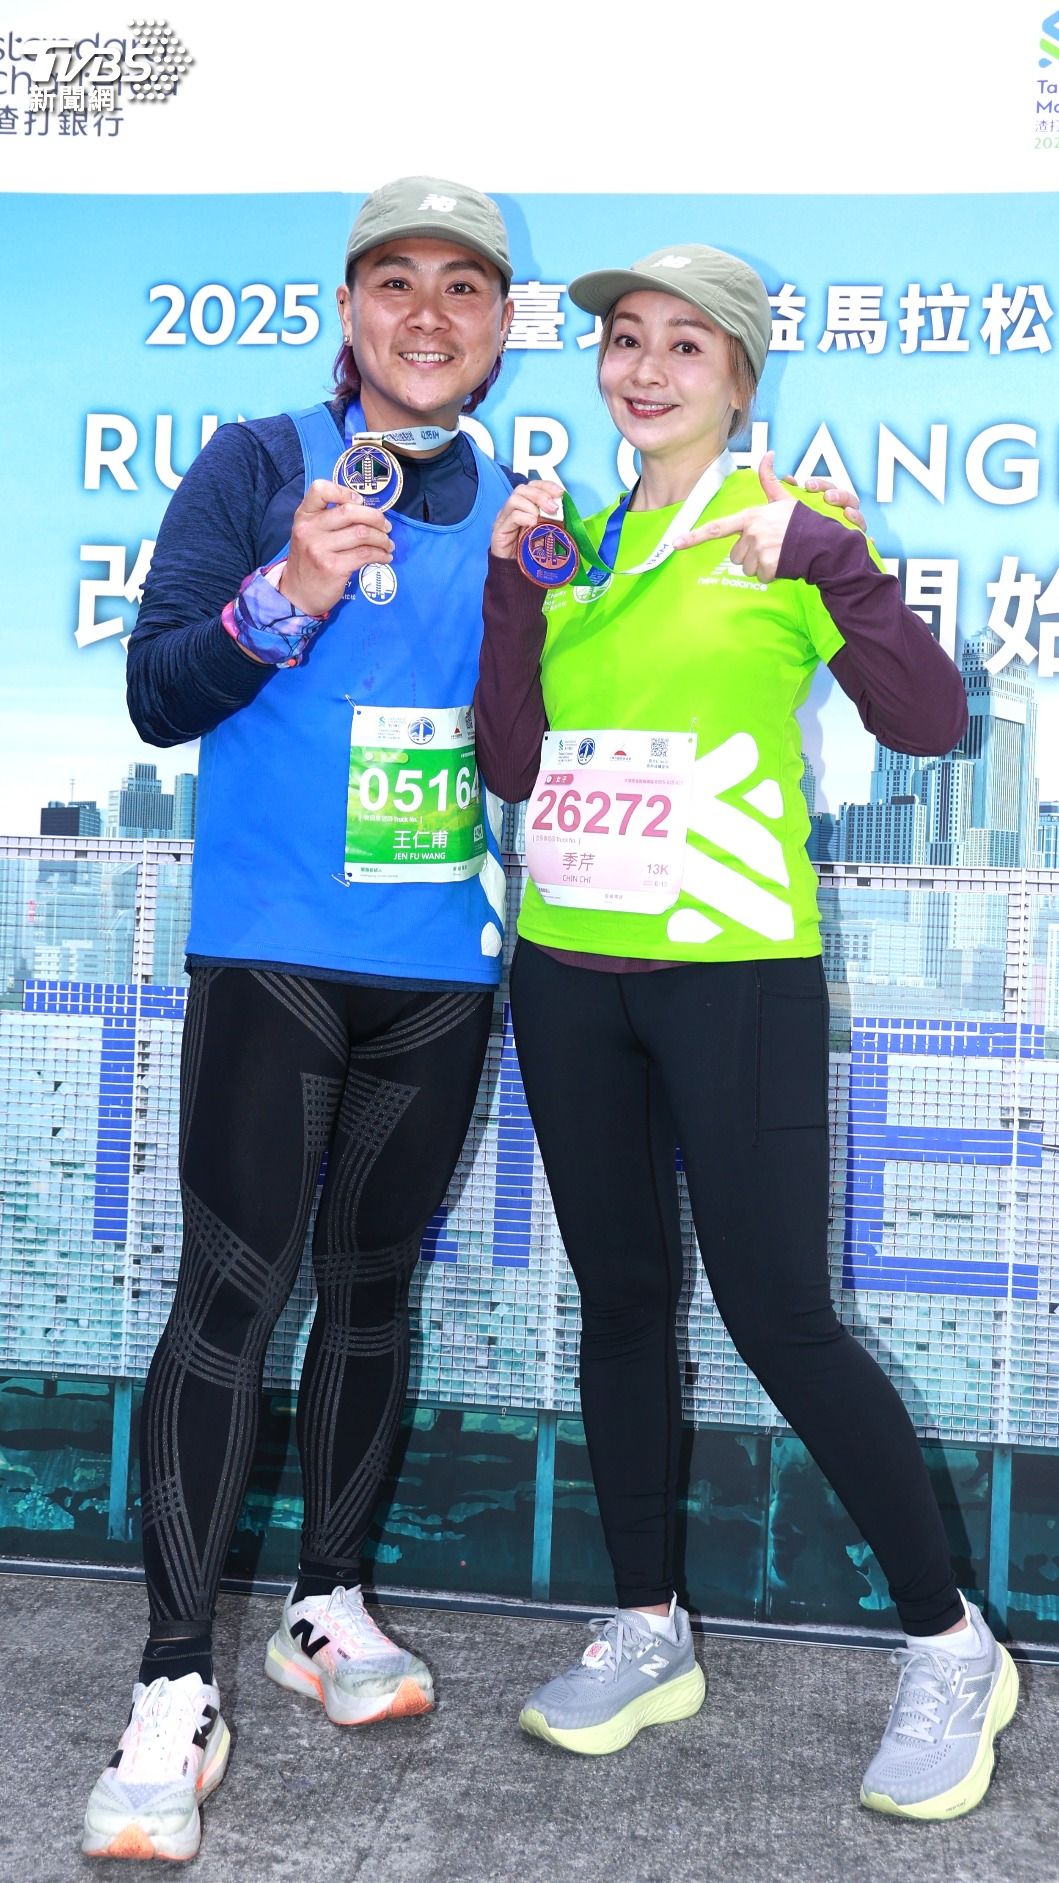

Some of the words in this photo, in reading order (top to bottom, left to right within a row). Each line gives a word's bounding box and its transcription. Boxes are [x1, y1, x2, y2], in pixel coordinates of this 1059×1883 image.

[144, 283, 320, 346] 2025
[83, 413, 247, 492] RU
[532, 789, 672, 838] 26272
[393, 830, 449, 849] 王仁甫
[393, 852, 407, 861] JEN
[410, 852, 419, 860] FU
[421, 852, 446, 860] WANG
[562, 852, 596, 871] 季芹
[647, 864, 669, 875] 13K
